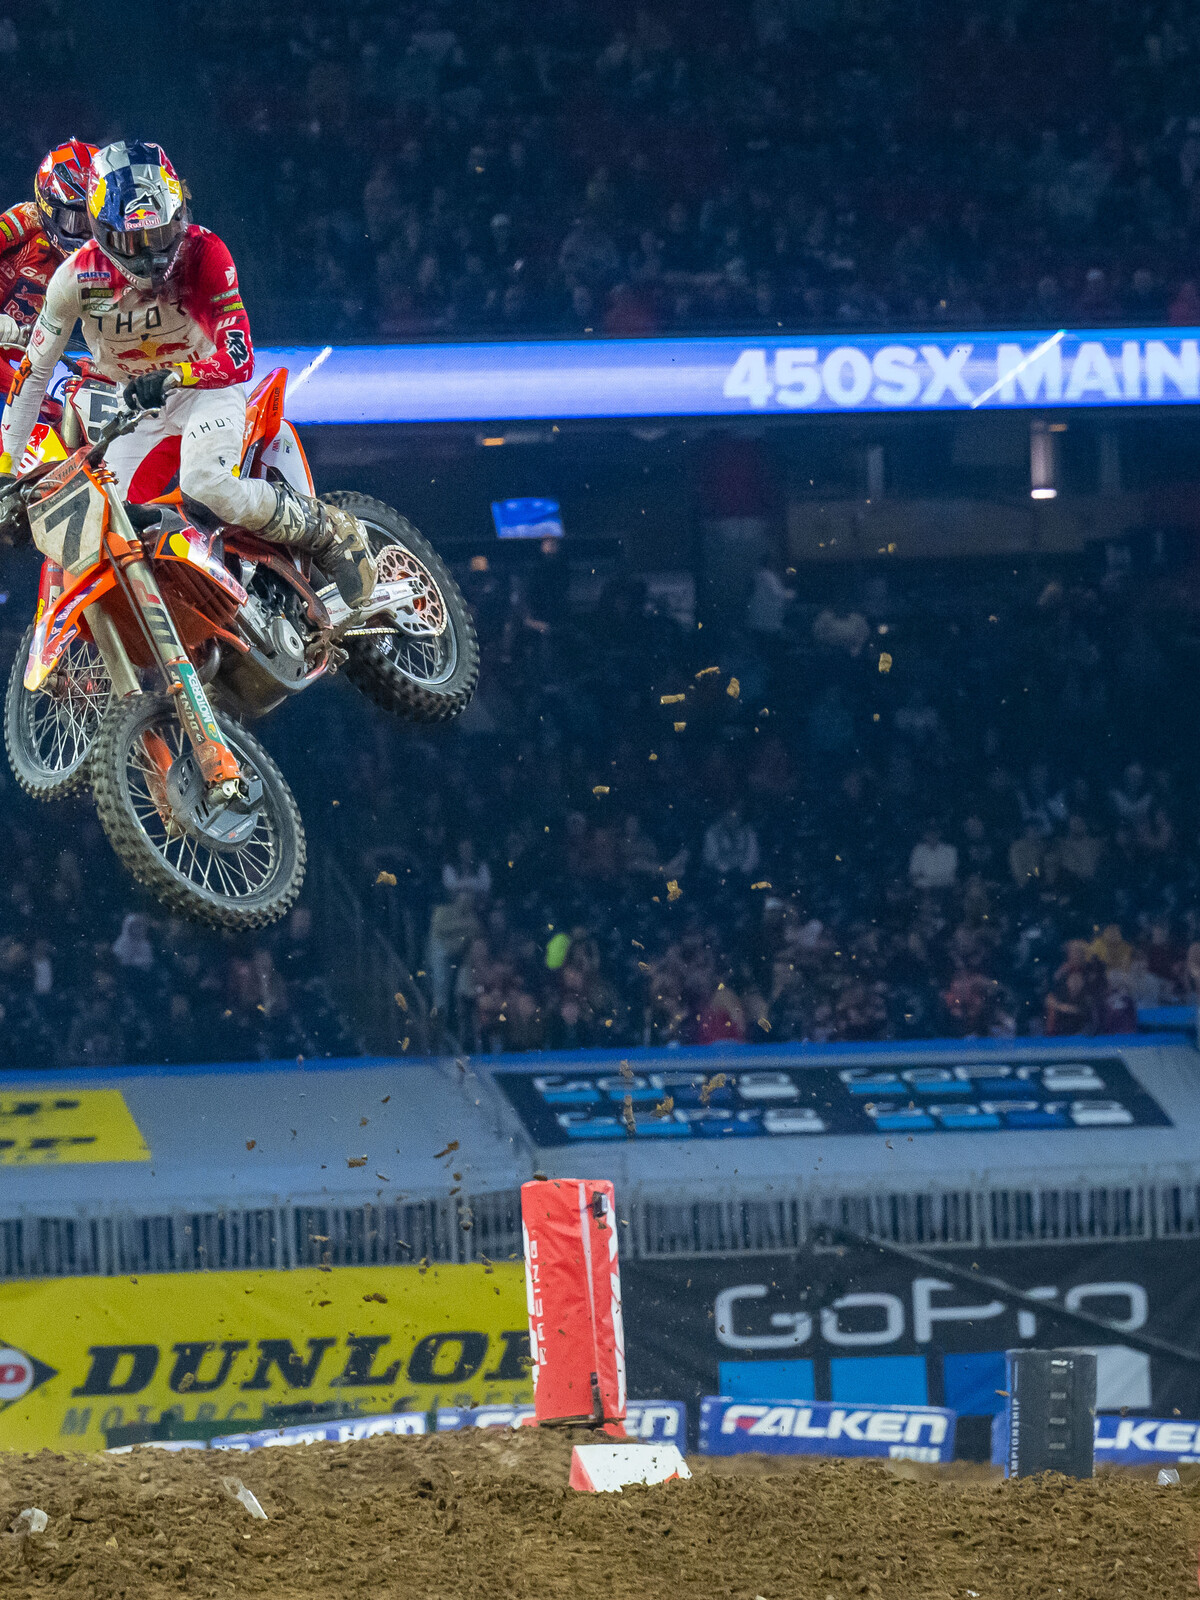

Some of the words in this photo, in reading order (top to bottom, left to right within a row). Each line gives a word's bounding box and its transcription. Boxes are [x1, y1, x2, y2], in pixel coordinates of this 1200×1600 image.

[76, 271, 112, 281] PARTS
[4, 299, 39, 326] Red
[723, 344, 973, 408] 450SX
[999, 339, 1200, 401] MAIN
[44, 486, 90, 570] 7
[186, 672, 214, 723] MOTOREX
[529, 1240, 548, 1366] RACING
[714, 1278, 1149, 1349] GoPro
[721, 1405, 949, 1444] FALKEN
[1010, 1397, 1020, 1478] AMPIONSHIP
[1094, 1420, 1200, 1452] LKE
